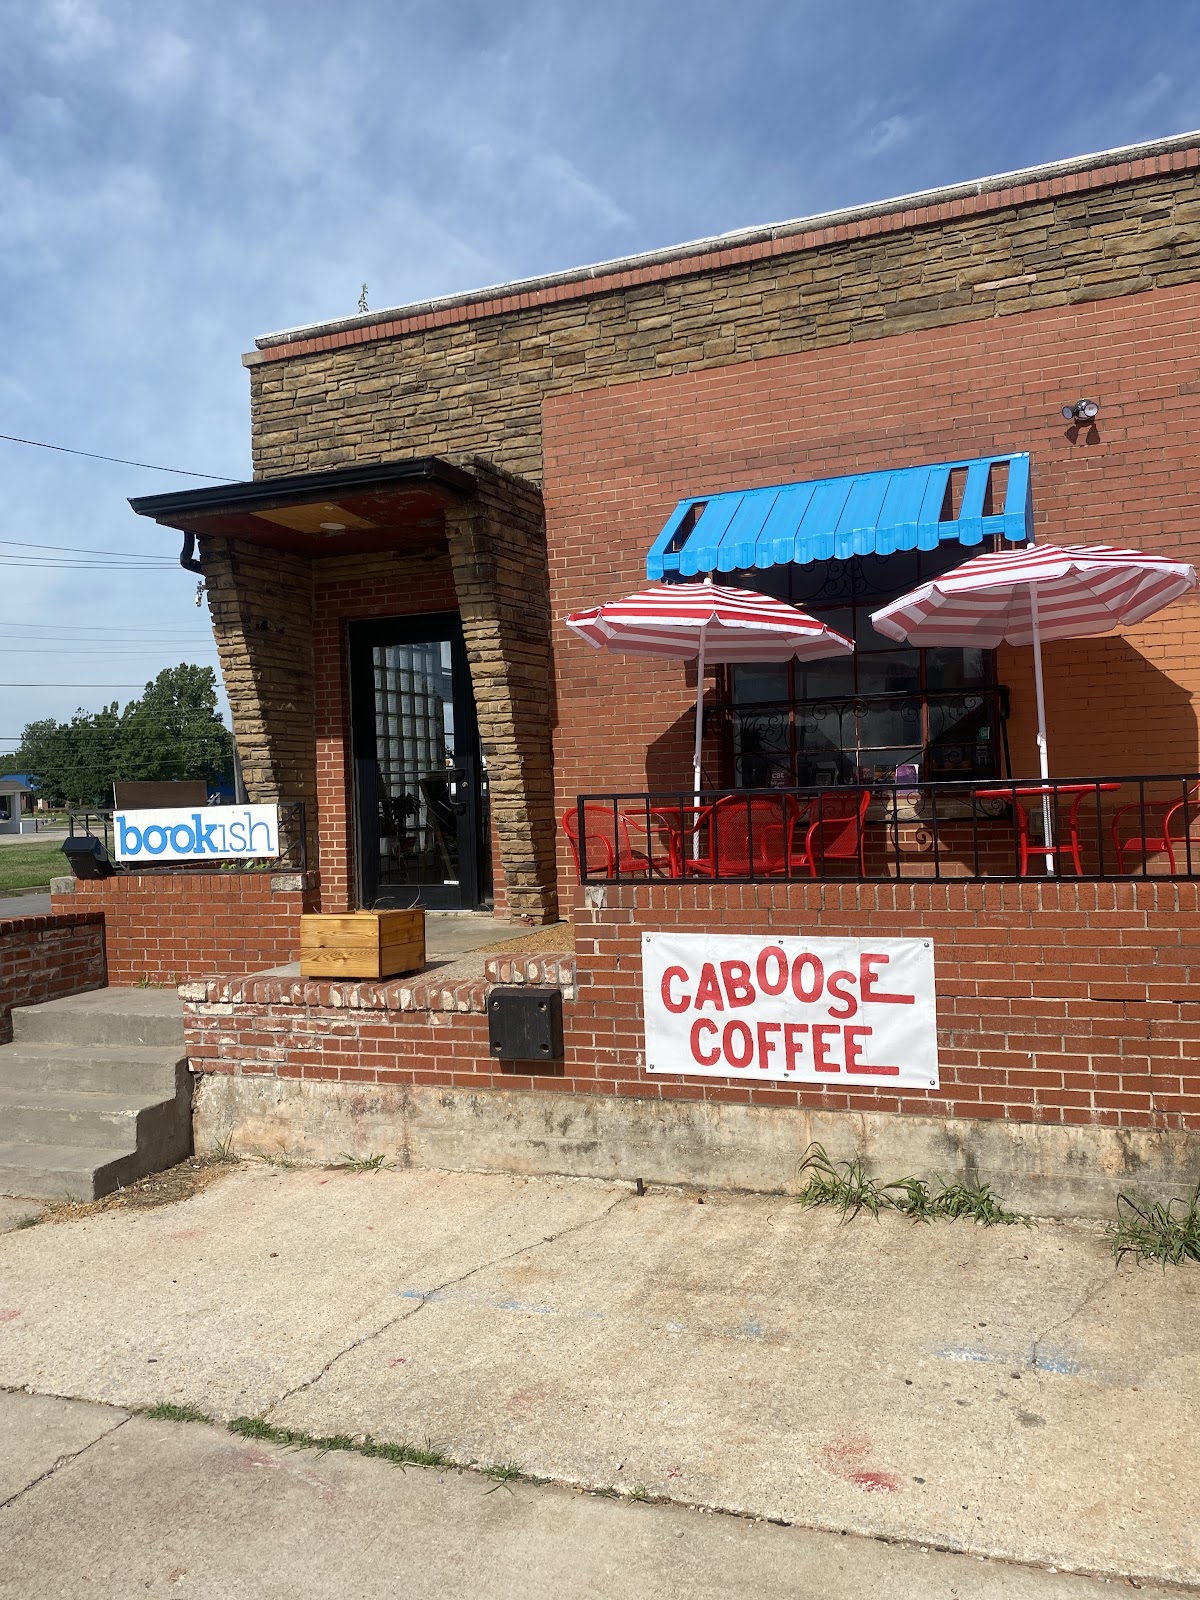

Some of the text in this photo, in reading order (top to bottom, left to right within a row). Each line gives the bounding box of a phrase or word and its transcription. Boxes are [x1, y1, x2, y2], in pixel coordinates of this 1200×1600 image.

[116, 811, 275, 855] bookish
[661, 946, 915, 1019] CABOOSE
[690, 1018, 899, 1075] COFFEE
